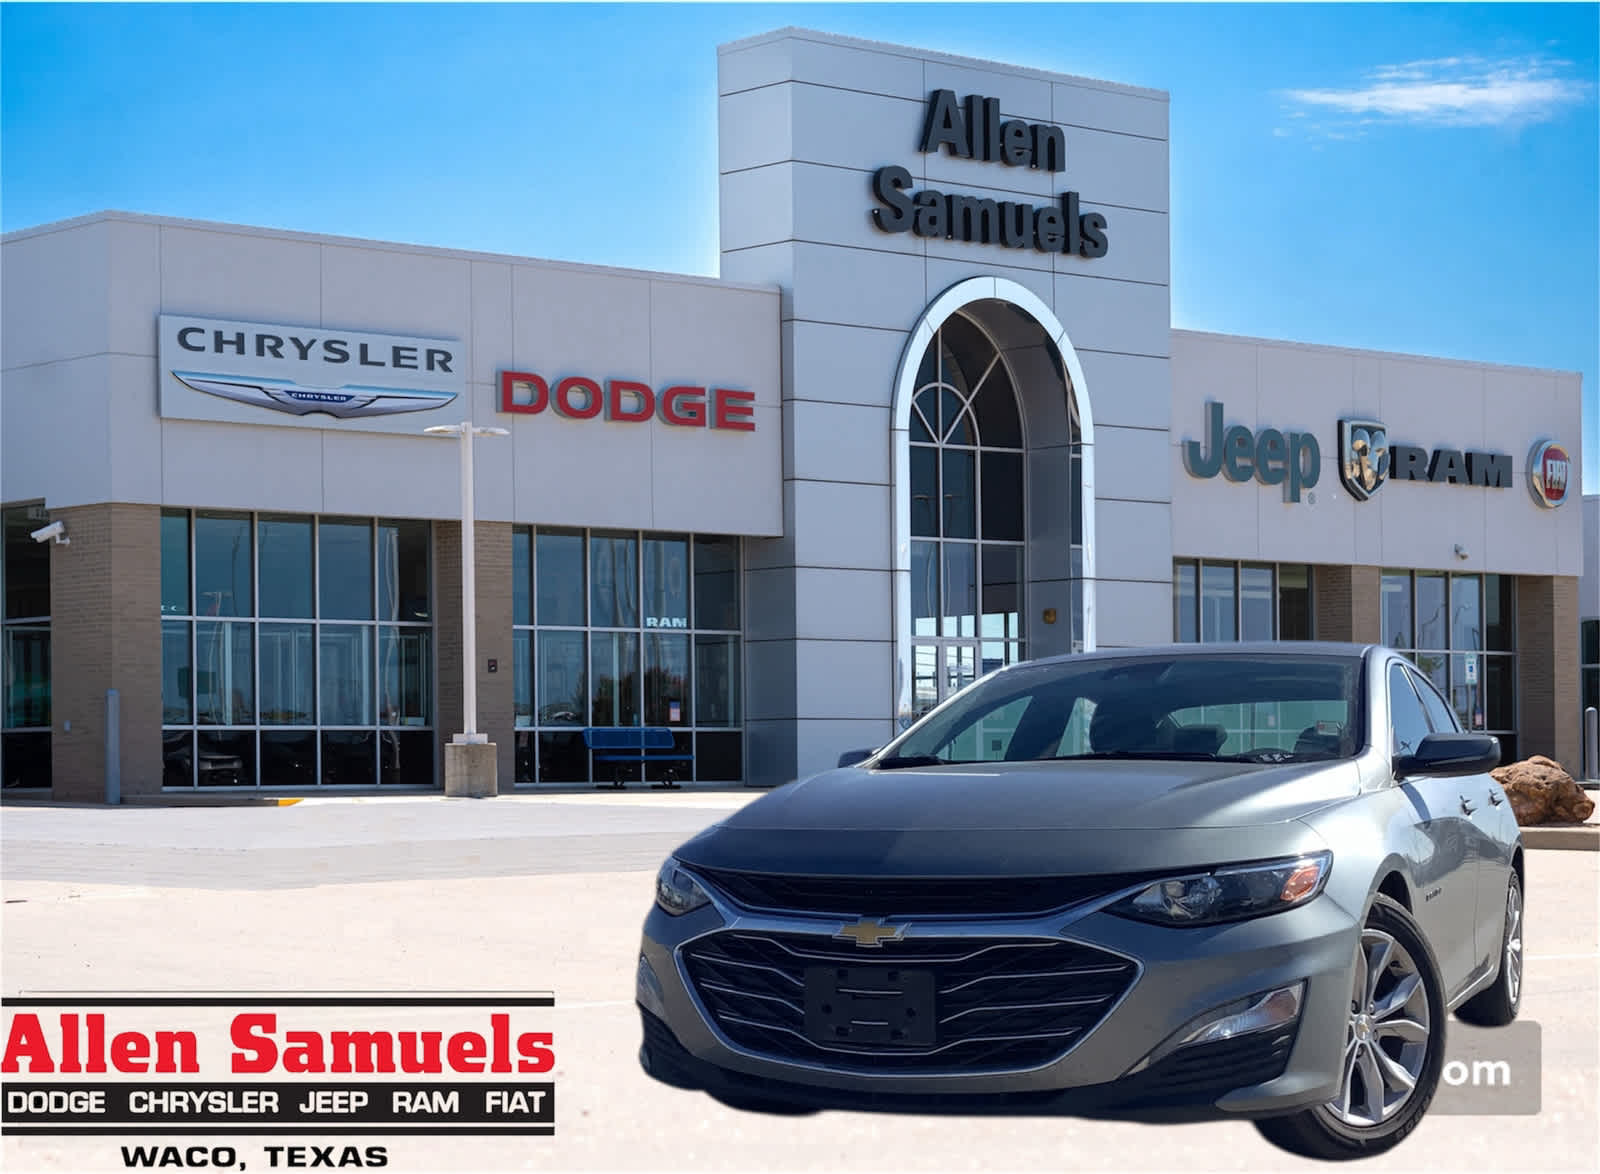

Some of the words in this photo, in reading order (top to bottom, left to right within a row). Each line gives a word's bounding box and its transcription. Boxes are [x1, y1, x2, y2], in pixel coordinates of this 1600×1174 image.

[919, 88, 1066, 172] Allen
[872, 165, 1108, 258] Samuels
[177, 327, 454, 373] CHRYSLER
[291, 392, 347, 401] CHRYSLER
[496, 370, 755, 432] DODGE
[1183, 401, 1321, 503] Jeep
[1389, 446, 1513, 488] RAM
[646, 617, 687, 628] RAM
